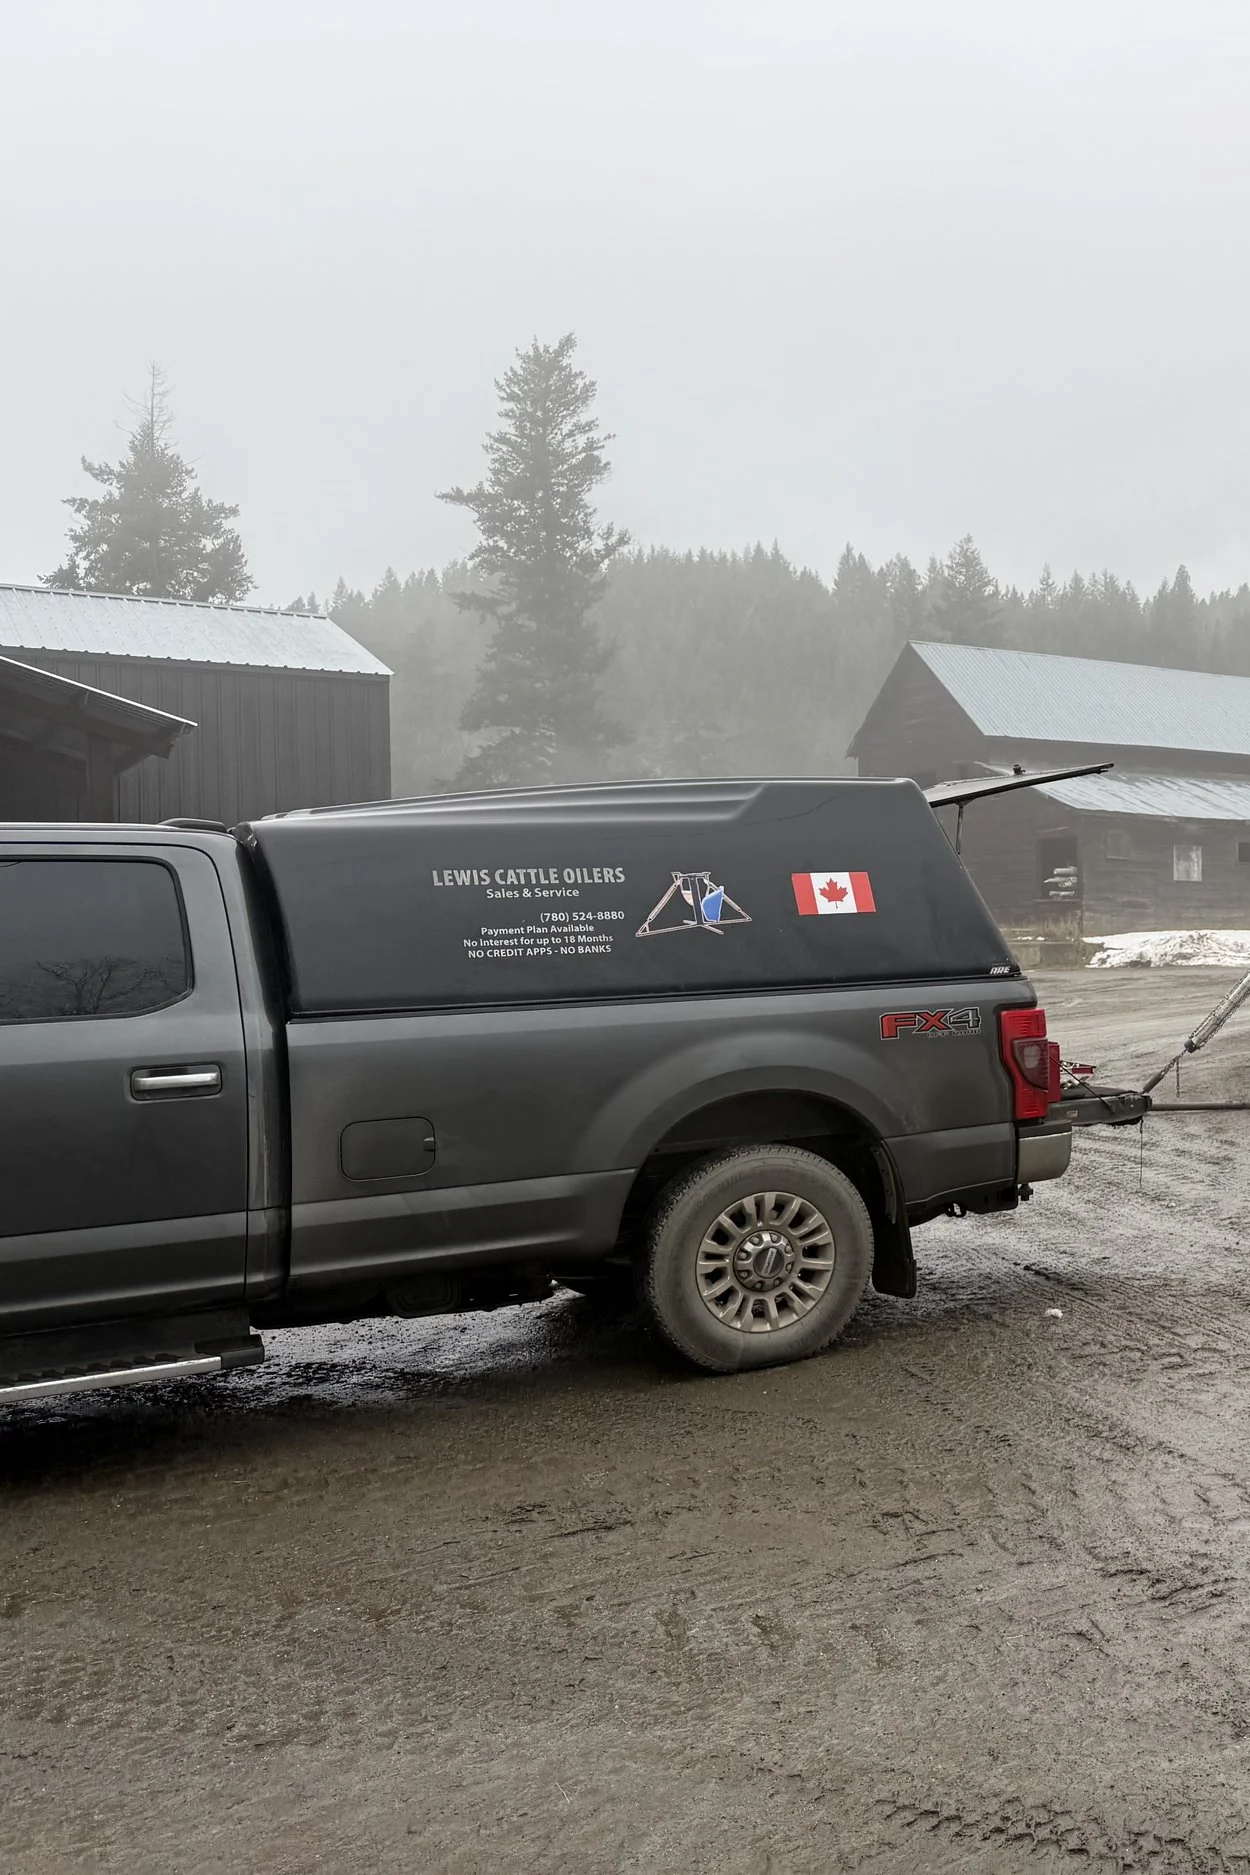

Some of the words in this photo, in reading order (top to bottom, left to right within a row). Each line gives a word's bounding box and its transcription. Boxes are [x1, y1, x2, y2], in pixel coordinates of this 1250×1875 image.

[432, 869, 490, 886] LEWIS
[495, 868, 559, 885] CATTLE
[563, 867, 625, 884] OILERS
[486, 887, 520, 899] Sales
[522, 888, 532, 898] &
[534, 887, 580, 898] Service
[540, 912, 570, 924] (780)
[572, 910, 625, 921] 524-8880
[481, 926, 525, 937] Payment
[526, 925, 548, 934] Plan
[550, 924, 595, 933] Available
[463, 939, 478, 948] No
[480, 938, 518, 947] Interest
[520, 937, 535, 946] for
[536, 937, 550, 946] up
[551, 936, 562, 945] to
[564, 935, 576, 944] 18
[578, 934, 613, 943] Months
[468, 950, 484, 958] NO
[487, 948, 524, 958] CREDIT
[526, 947, 553, 956] APPS
[560, 946, 576, 955] NO
[578, 944, 612, 954] BANKS
[880, 1007, 981, 1040] FX4
